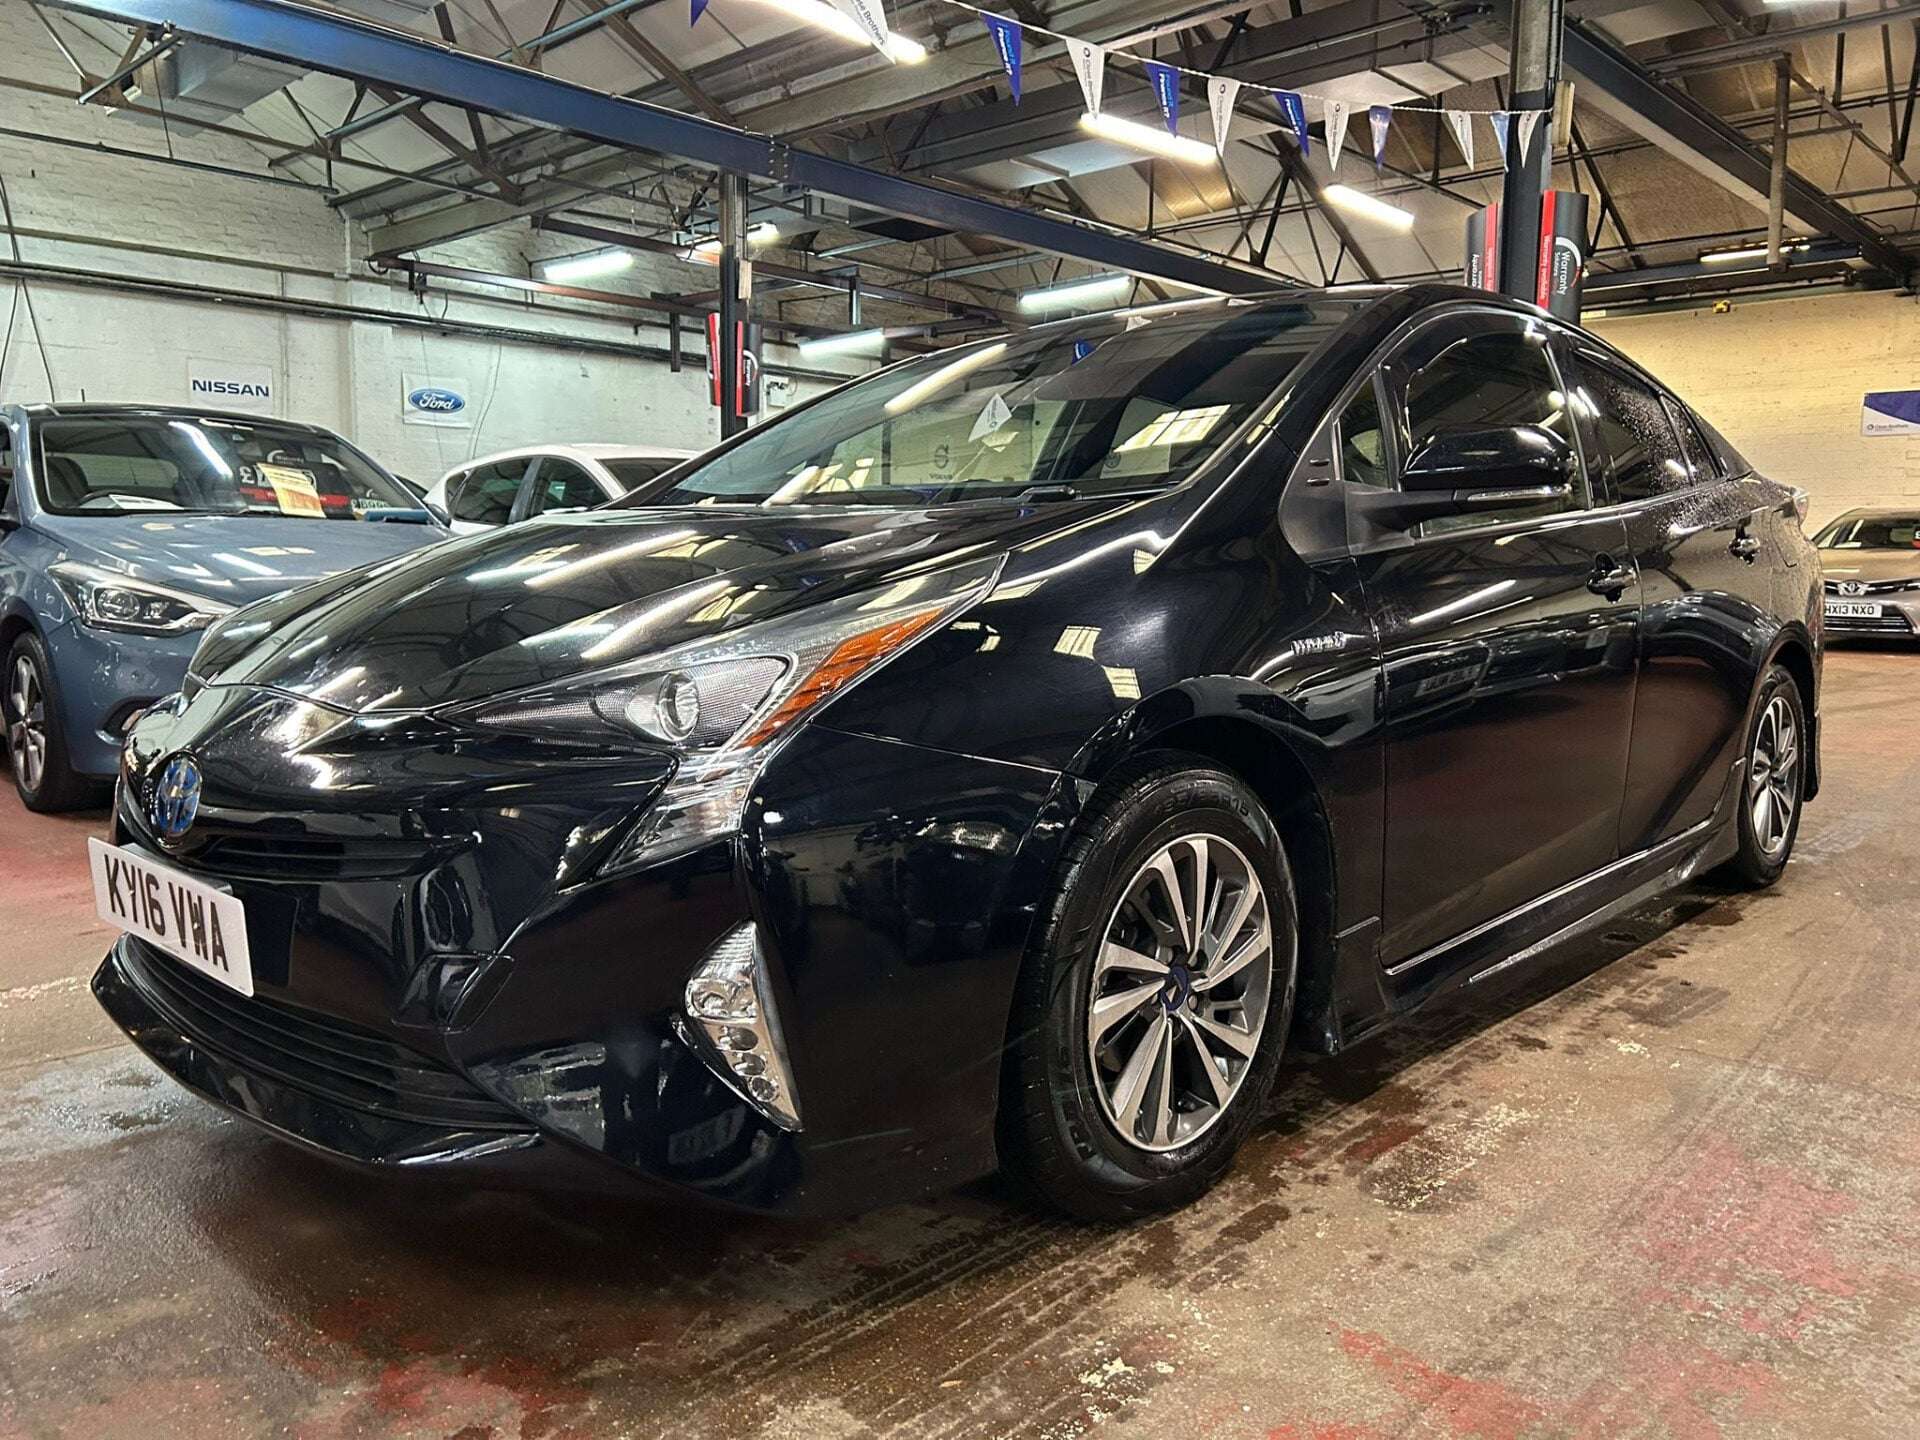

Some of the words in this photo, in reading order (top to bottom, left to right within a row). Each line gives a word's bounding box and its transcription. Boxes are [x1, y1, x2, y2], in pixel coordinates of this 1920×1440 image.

[863, 10, 885, 46] Brothers
[1472, 253, 1480, 287] arranty
[1557, 250, 1571, 295] Warranty
[192, 379, 269, 397] NISSAN
[419, 391, 455, 410] Ford
[104, 854, 166, 937] KY16
